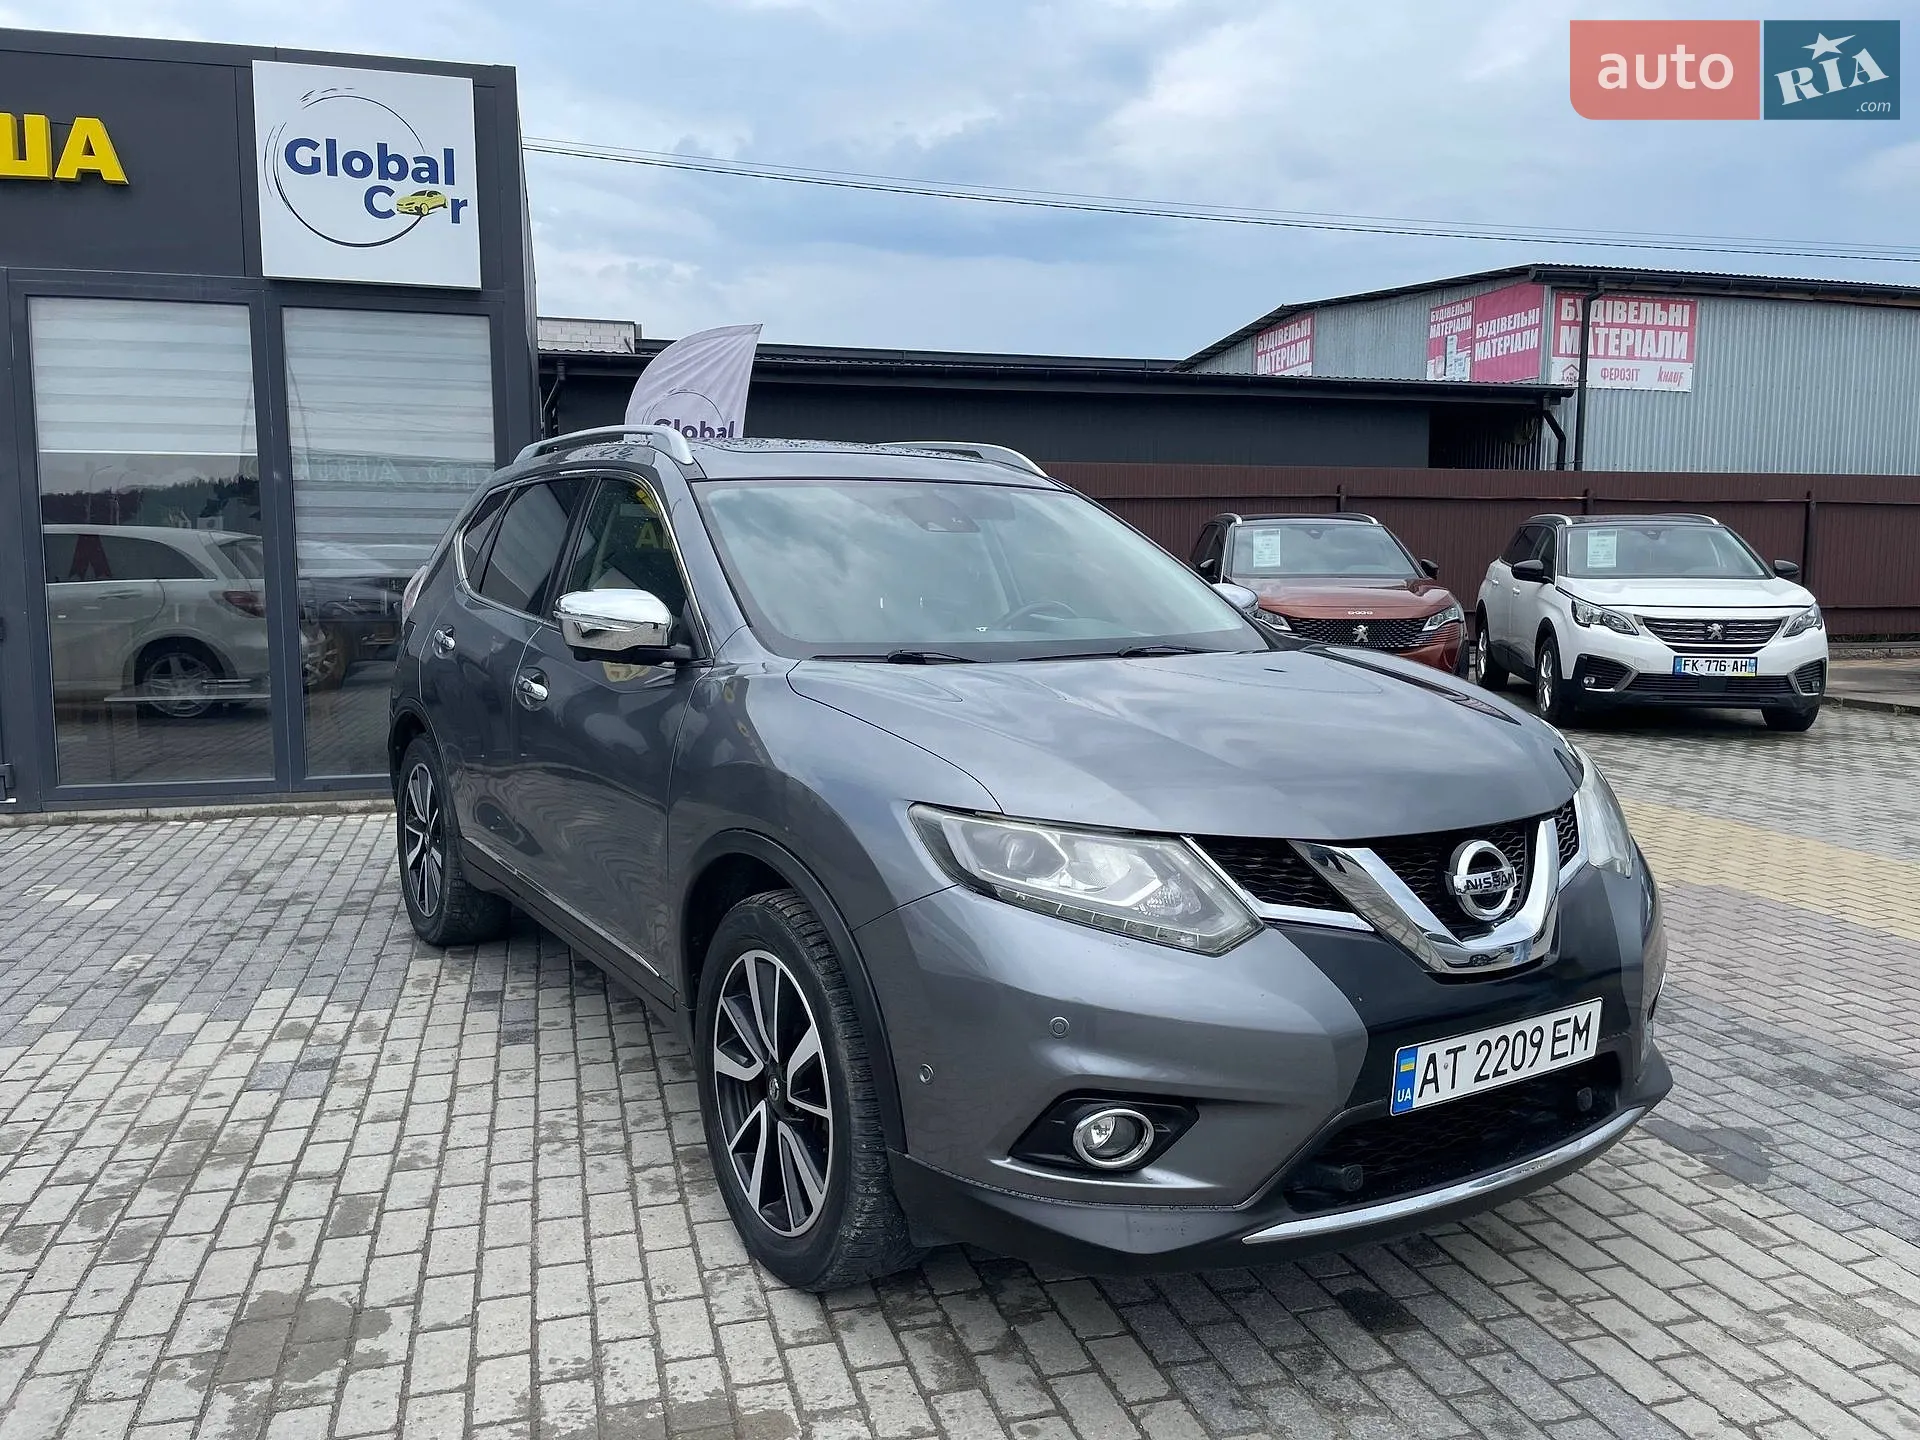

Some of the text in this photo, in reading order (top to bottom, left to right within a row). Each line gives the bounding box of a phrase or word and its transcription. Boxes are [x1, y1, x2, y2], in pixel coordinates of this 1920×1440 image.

[285, 138, 457, 186] Global
[364, 185, 468, 224] Cr
[1430, 315, 1472, 338] МАТЕРІАЛИ
[1431, 301, 1472, 322] БУДІВЕЛЬНІ
[1476, 308, 1539, 338] БУДІВЕЛЬНІ
[1258, 318, 1311, 352] БУДІВЕЛЬНІ
[1475, 328, 1538, 361] МАТЕРІАЛИ
[1258, 339, 1310, 374] МАТЕРІАЛИ
[1683, 659, 1747, 672] FK-776-AH
[1465, 871, 1514, 890] NISSAN
[1418, 1011, 1592, 1098] AT 2209 EM
[1397, 1088, 1411, 1102] UA
